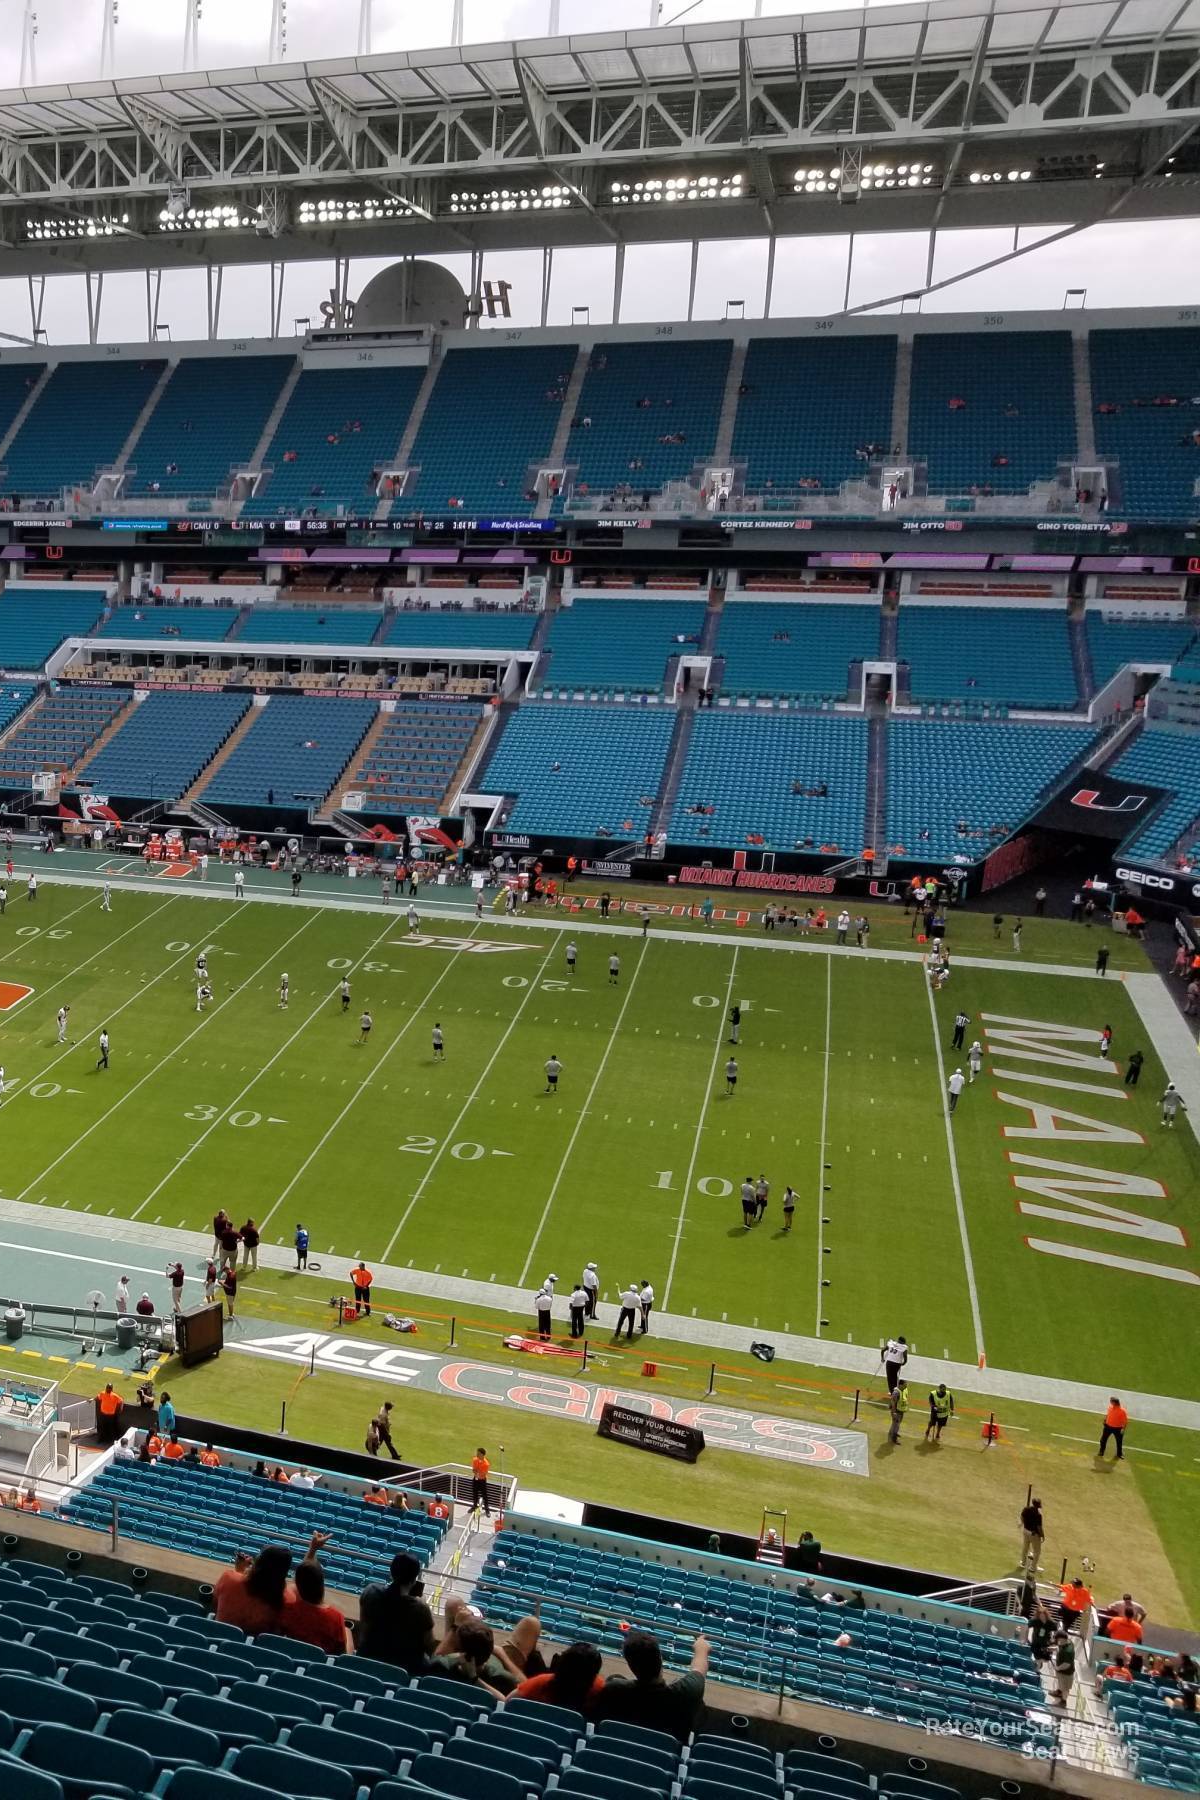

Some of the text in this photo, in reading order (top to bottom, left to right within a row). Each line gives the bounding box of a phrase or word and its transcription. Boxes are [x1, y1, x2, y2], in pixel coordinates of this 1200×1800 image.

[983, 316, 1003, 326] 350
[505, 331, 522, 341] 347
[655, 326, 673, 335] 348
[613, 520, 638, 528] KELLY
[720, 520, 795, 528] CORTEZ KENNEDY
[903, 522, 945, 530] JIM OTTO
[1037, 522, 1111, 532] GINO TORRETTA
[597, 861, 631, 871] SYLVESTER
[679, 866, 836, 894] MIAMI HURRICANES
[1115, 867, 1174, 891] GEICO
[183, 1104, 263, 1127] 30
[398, 1135, 485, 1161] 20
[648, 1170, 734, 1197] 10
[223, 1332, 442, 1382] ACC
[613, 1410, 644, 1425] RECOVER
[645, 1419, 665, 1430] YOUR
[643, 1438, 670, 1450] INSTITUTE
[644, 1432, 687, 1449] SPORTS MEDICINE
